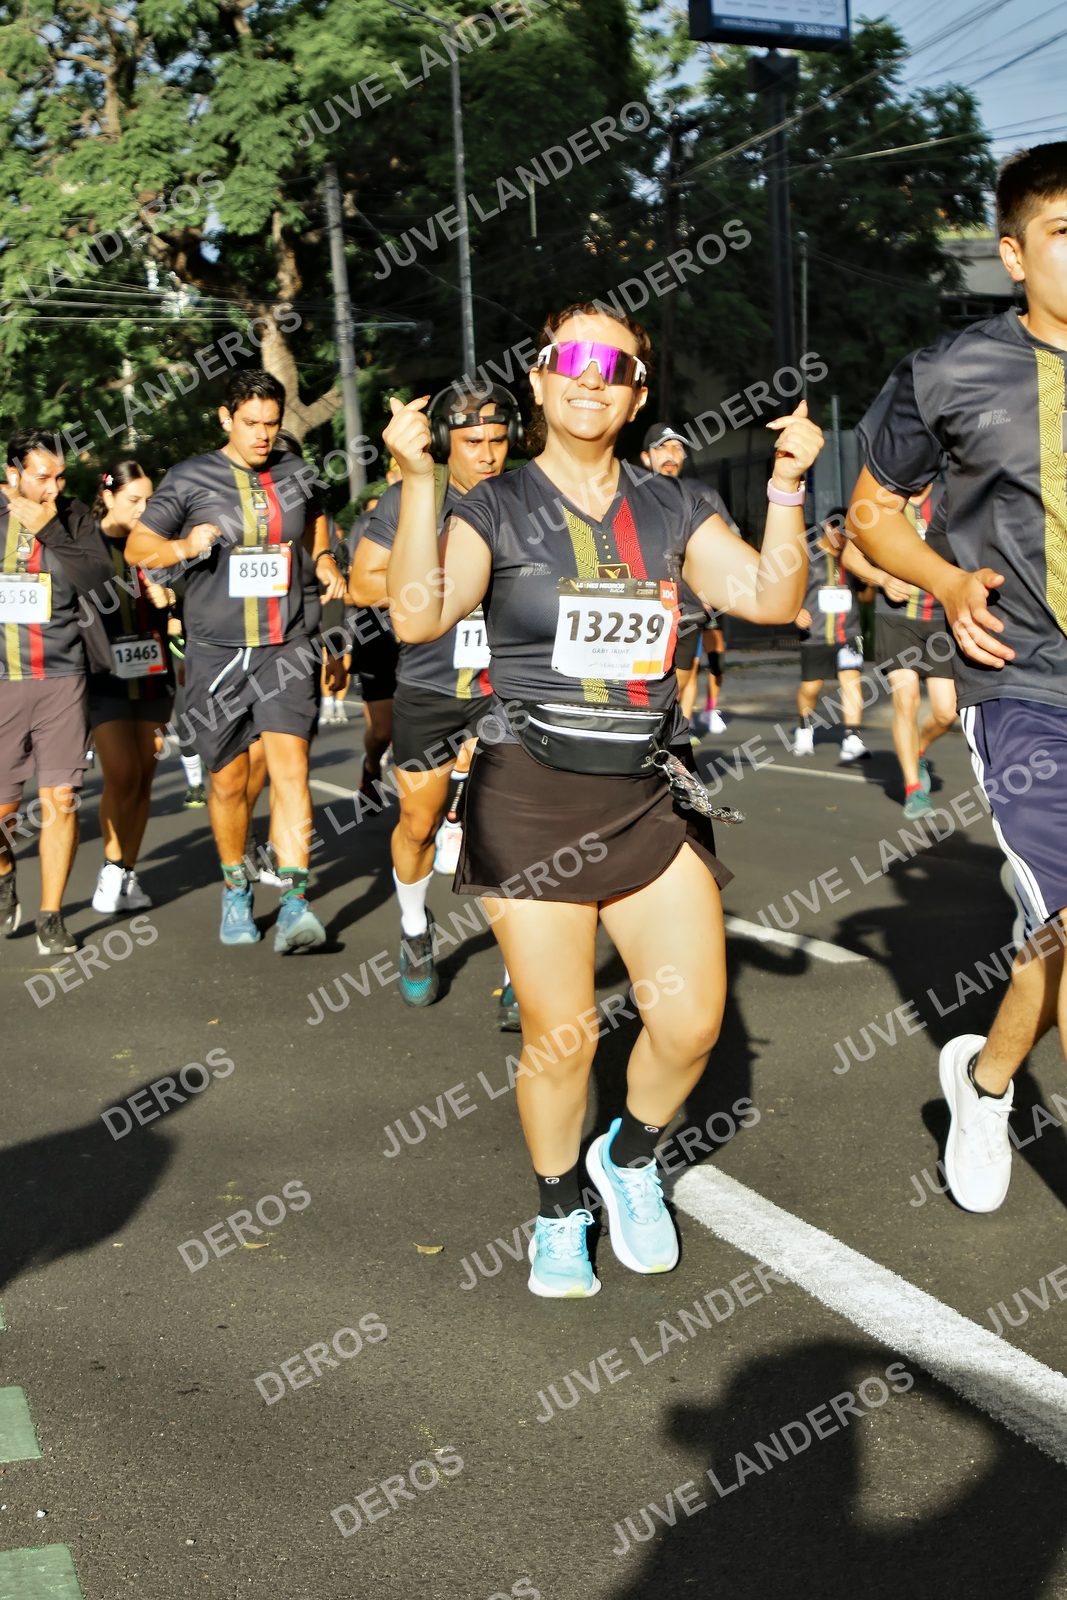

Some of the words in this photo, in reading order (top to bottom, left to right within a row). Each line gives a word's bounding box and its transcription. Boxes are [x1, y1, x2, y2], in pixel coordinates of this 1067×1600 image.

[239, 562, 278, 578] 8505
[566, 610, 665, 645] 13239
[462, 629, 488, 647] 11
[115, 645, 158, 664] 13465
